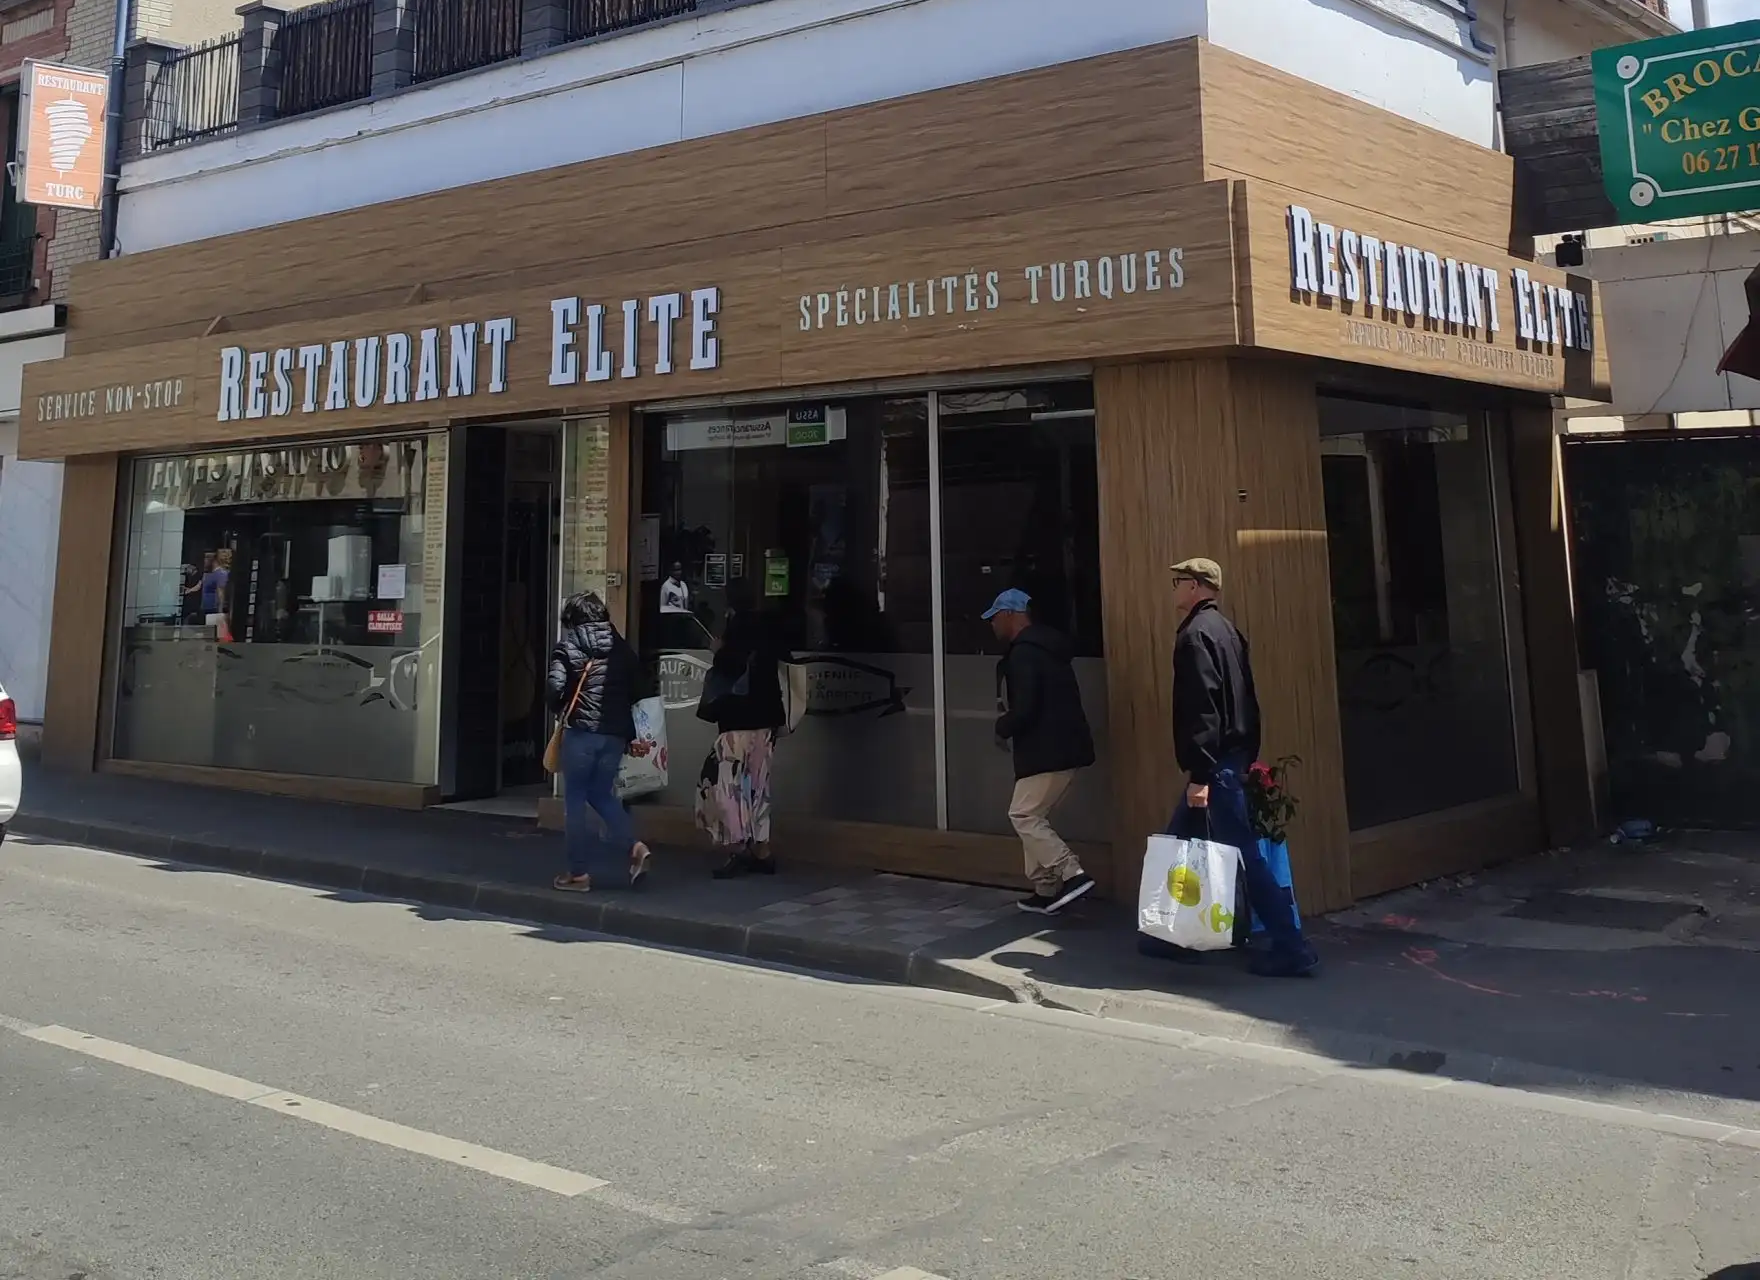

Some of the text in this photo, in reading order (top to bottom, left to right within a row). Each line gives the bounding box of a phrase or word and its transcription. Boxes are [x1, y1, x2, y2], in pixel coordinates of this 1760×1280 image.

[38, 74, 104, 95] RESTAURANT
[1661, 117, 1732, 143] Chez
[1682, 150, 1711, 175] 06
[1715, 144, 1739, 170] 27
[45, 183, 84, 200] TURC
[1286, 204, 1500, 332] RESTAURANT
[800, 247, 1184, 331] SPÉCIALITÉS TURQUES
[217, 287, 720, 421] RESTAURANT ELITE
[37, 379, 183, 421] SERVICE NON-STOP
[660, 680, 689, 699] LITE
